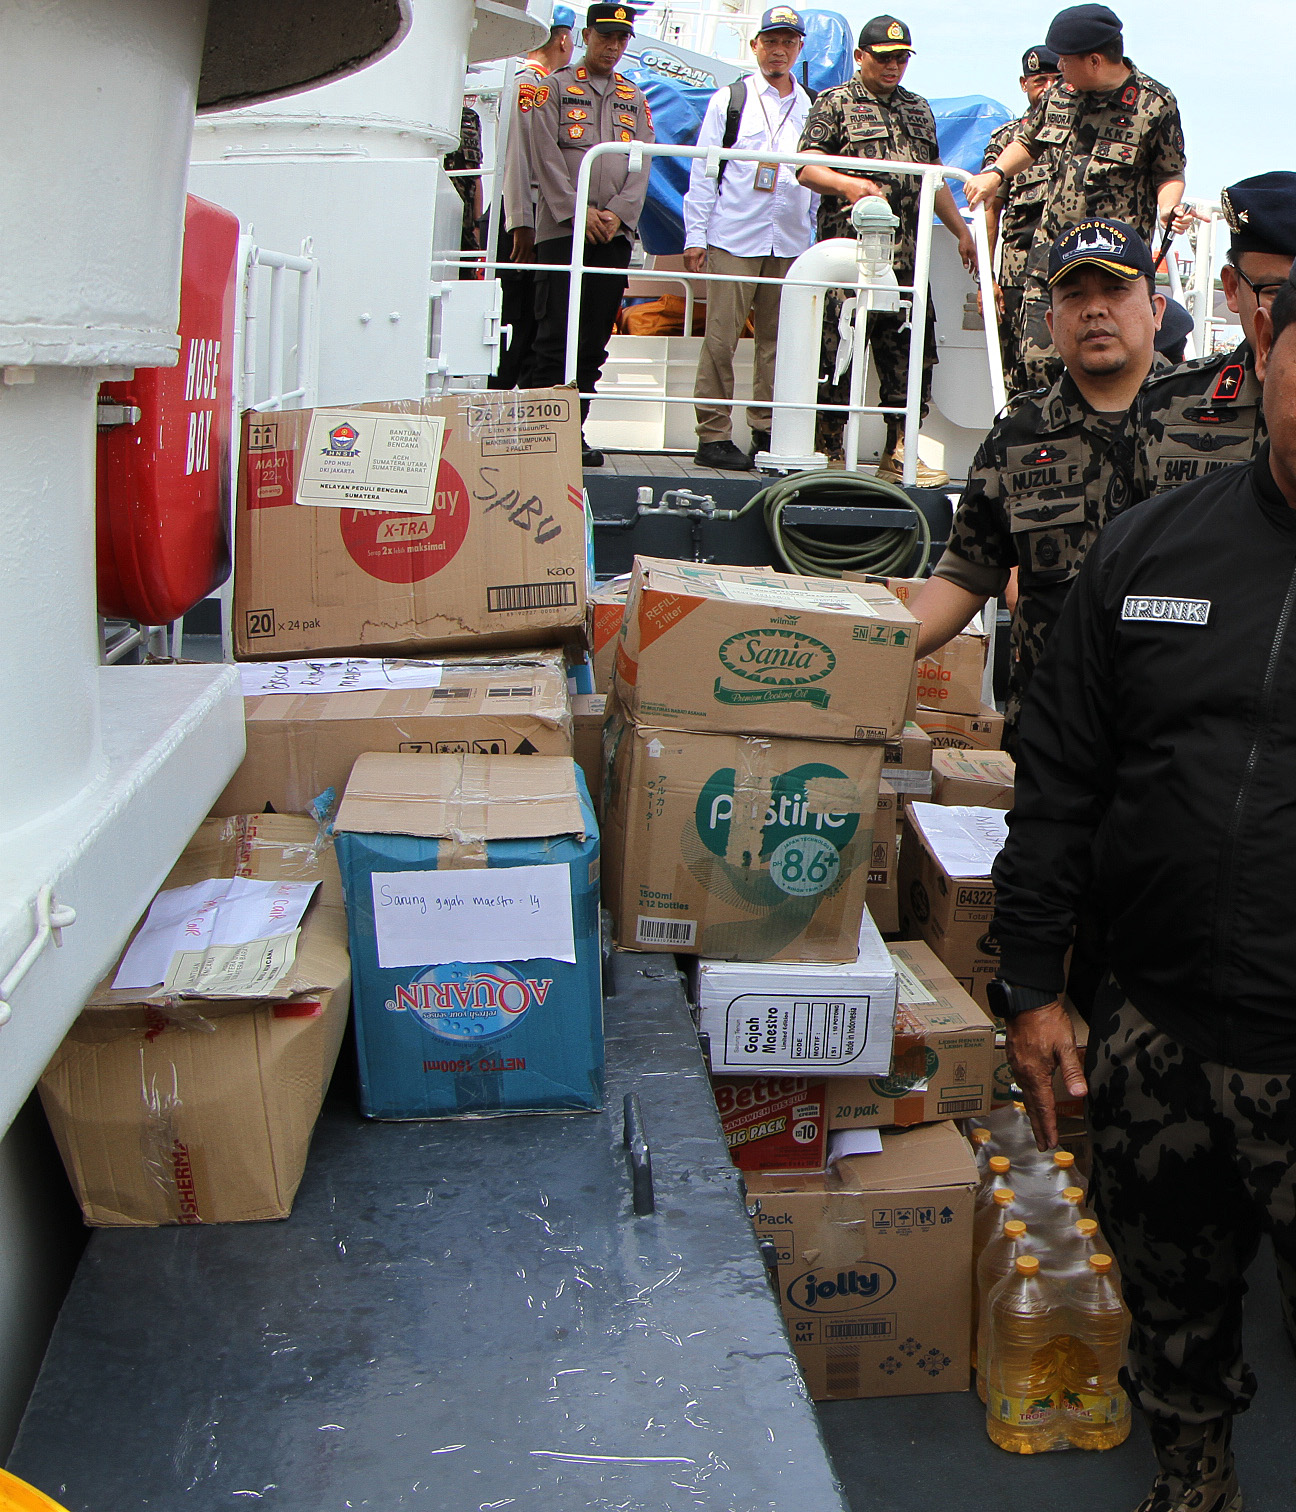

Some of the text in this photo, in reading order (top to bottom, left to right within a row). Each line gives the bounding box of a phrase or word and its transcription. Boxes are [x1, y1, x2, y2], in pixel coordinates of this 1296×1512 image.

[642, 53, 708, 81] OCEAN
[613, 102, 638, 114] POLRI
[907, 115, 929, 124] KKP
[1047, 112, 1071, 125] HENDRA
[1104, 127, 1134, 141] KKP
[1070, 222, 1092, 237] ORCA
[185, 337, 221, 400] HOSE
[507, 404, 561, 419] 452100
[389, 429, 421, 437] BANTUAN
[185, 410, 213, 475] BOX
[255, 458, 285, 470] MAXI
[1164, 459, 1234, 482] SAIFUL UMA
[1012, 464, 1077, 491] NUZUL F
[435, 490, 460, 516] ay
[384, 521, 429, 537] X-TRA
[382, 546, 393, 555] 2x
[407, 541, 446, 553] maksimal
[645, 594, 680, 621] REFILL
[1127, 600, 1203, 622] IPUNK
[250, 614, 271, 633] 20
[287, 620, 300, 630] 24
[302, 618, 321, 631] pak
[655, 604, 684, 630] 2 liter
[770, 616, 798, 626] wilmar
[853, 627, 885, 639] SNI 7
[739, 638, 814, 669] Sania
[917, 664, 951, 681] elola
[731, 688, 809, 703] Premium Cooking Oil
[917, 685, 949, 700] pee
[931, 737, 974, 750] NYAKITA
[657, 775, 667, 817] アルカリ
[783, 837, 833, 851] JAPAN TECHNOLOGY
[380, 884, 427, 914] Sarung
[435, 895, 465, 911] gajah
[472, 895, 514, 908] maestro
[640, 889, 672, 900] 1500ml
[960, 890, 996, 904] 64322
[646, 900, 655, 908] 12
[657, 901, 689, 910] bottles
[423, 1010, 497, 1020] refresh your senses
[744, 1017, 763, 1053] Gajah
[762, 1007, 778, 1053] Maestro
[845, 1007, 857, 1056] Made in Indonesia
[795, 1038, 803, 1057] KODE
[813, 1036, 821, 1057] MOTIF
[423, 1058, 526, 1073] NETTO 1500ml
[714, 1077, 808, 1116] Better
[723, 1092, 807, 1131] SANDWICH BISCUIT
[835, 1103, 879, 1118] 20 pak
[725, 1117, 786, 1146] BIG PACK
[801, 1124, 816, 1139] 10
[758, 1213, 793, 1225] Pack
[879, 1212, 886, 1220] 7
[940, 1217, 952, 1225] UP
[805, 1270, 880, 1309] jolly
[795, 1321, 813, 1331] GT
[795, 1332, 814, 1342] MT
